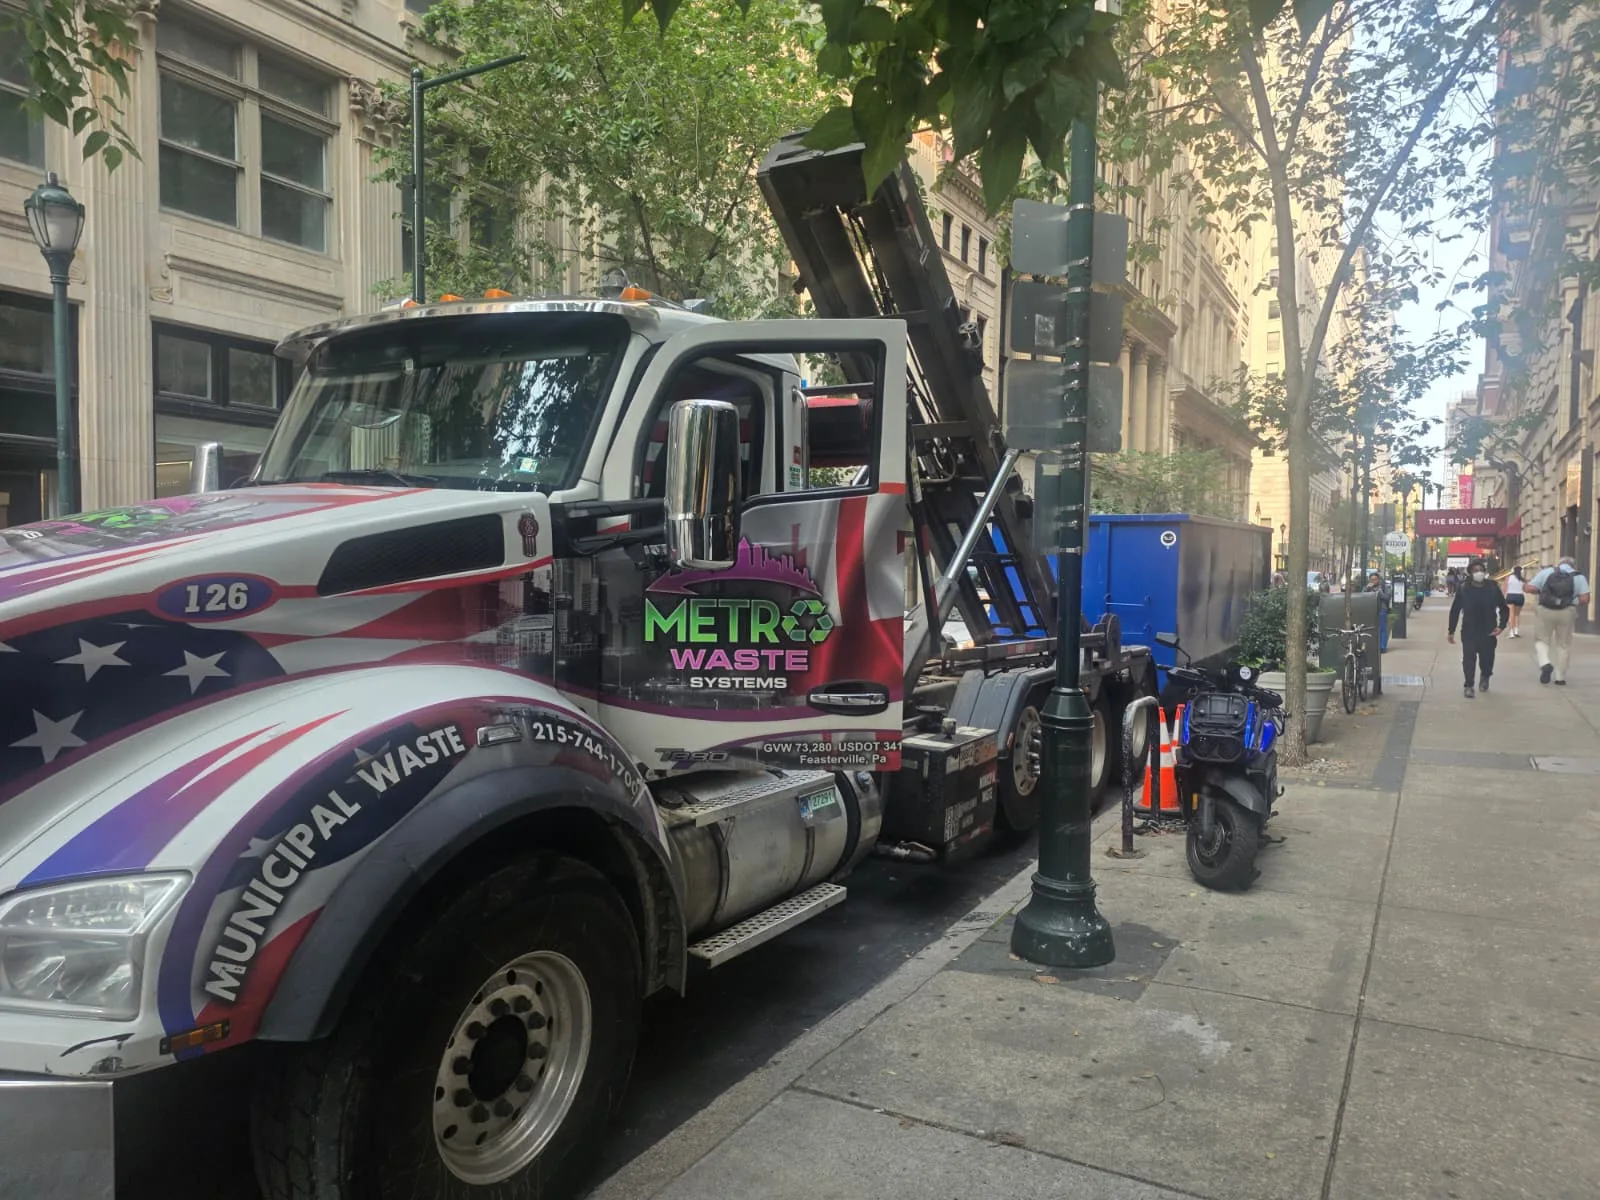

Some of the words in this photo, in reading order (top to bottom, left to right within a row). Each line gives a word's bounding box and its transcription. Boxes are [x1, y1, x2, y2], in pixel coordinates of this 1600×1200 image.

[1428, 518, 1446, 526] THE
[1448, 517, 1496, 525] BELLEVUE
[185, 582, 249, 613] 126
[670, 648, 808, 671] WASTE
[690, 676, 787, 689] SYSTEMS
[763, 743, 792, 753] GVW
[796, 742, 832, 753] 73,280
[838, 741, 880, 752] USDOT
[800, 754, 869, 765] Feasterville,
[872, 753, 887, 764] Pa
[205, 790, 362, 1002] MUNICIPAL
[356, 725, 466, 793] WASTE
